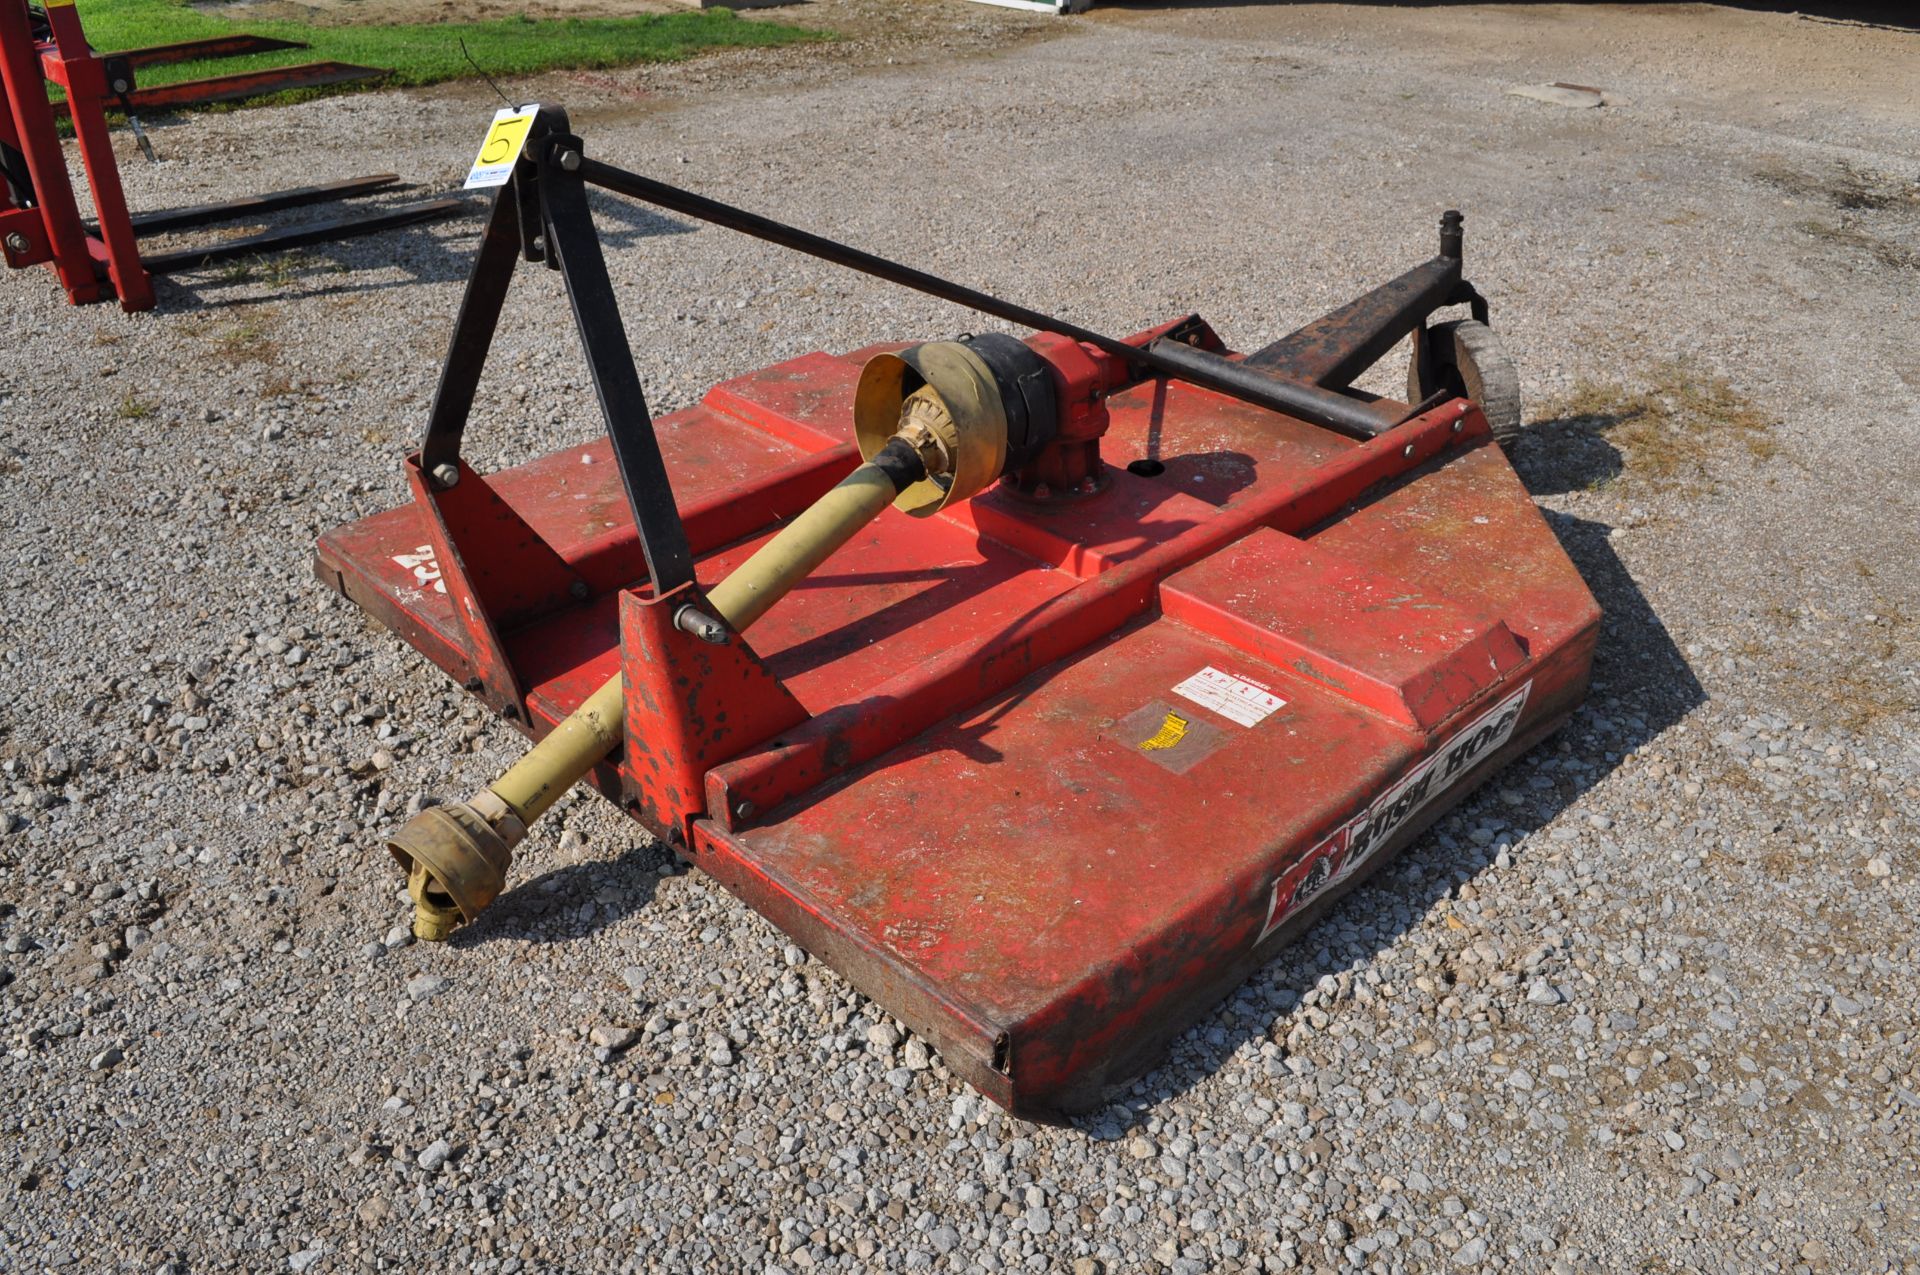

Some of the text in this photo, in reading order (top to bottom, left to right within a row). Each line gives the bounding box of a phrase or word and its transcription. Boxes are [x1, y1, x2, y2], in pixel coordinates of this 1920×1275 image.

[481, 118, 524, 164] 5
[1238, 674, 1272, 691] DANGER
[1347, 709, 1517, 866] BUSH HOG
